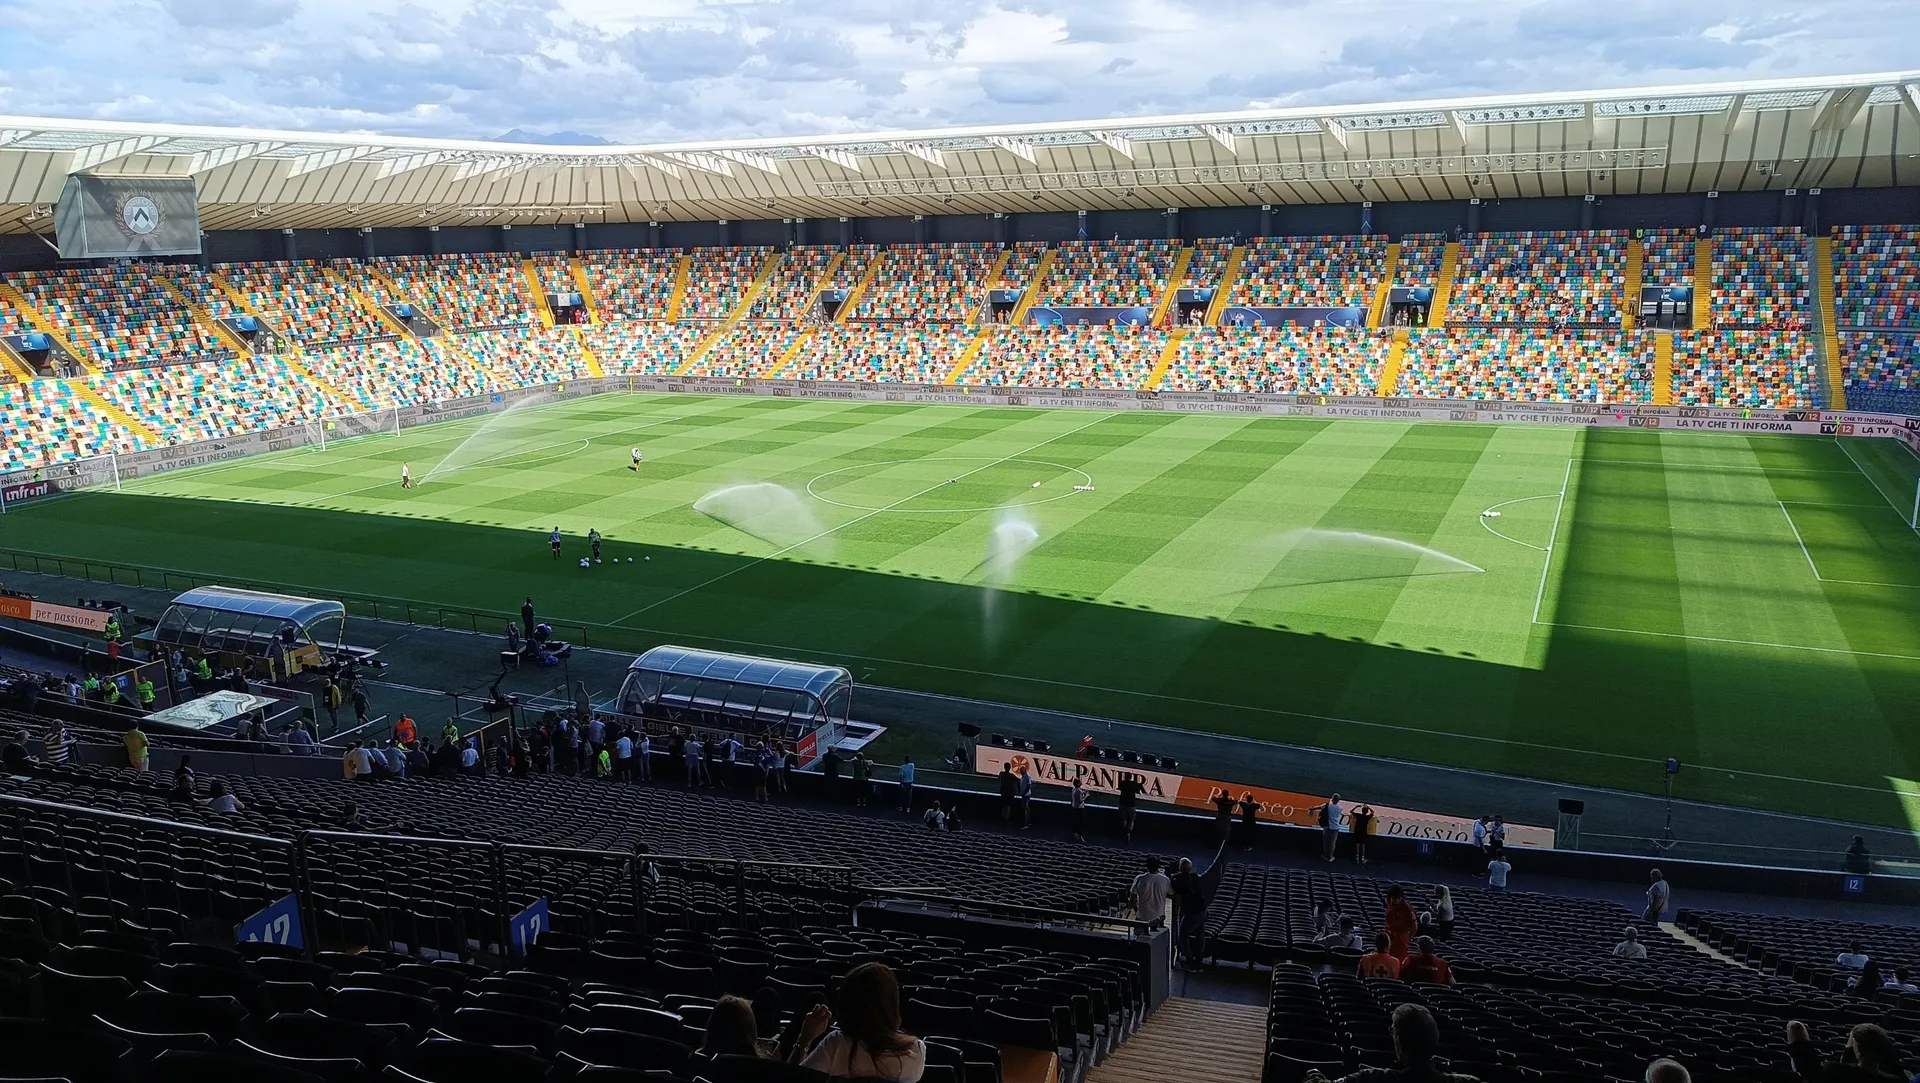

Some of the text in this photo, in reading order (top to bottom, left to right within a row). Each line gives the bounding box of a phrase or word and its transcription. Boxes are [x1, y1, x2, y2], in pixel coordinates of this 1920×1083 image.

[1552, 416, 1597, 424] INFORMA
[1708, 420, 1726, 429] CHE
[1743, 422, 1792, 431] INFORMA
[153, 464, 164, 472] LA
[166, 462, 176, 470] TV
[179, 458, 196, 467] CHE
[208, 449, 245, 462] INFORMA
[58, 476, 90, 490] 00:00
[36, 608, 98, 628] per passione.
[1849, 880, 1858, 890] 12
